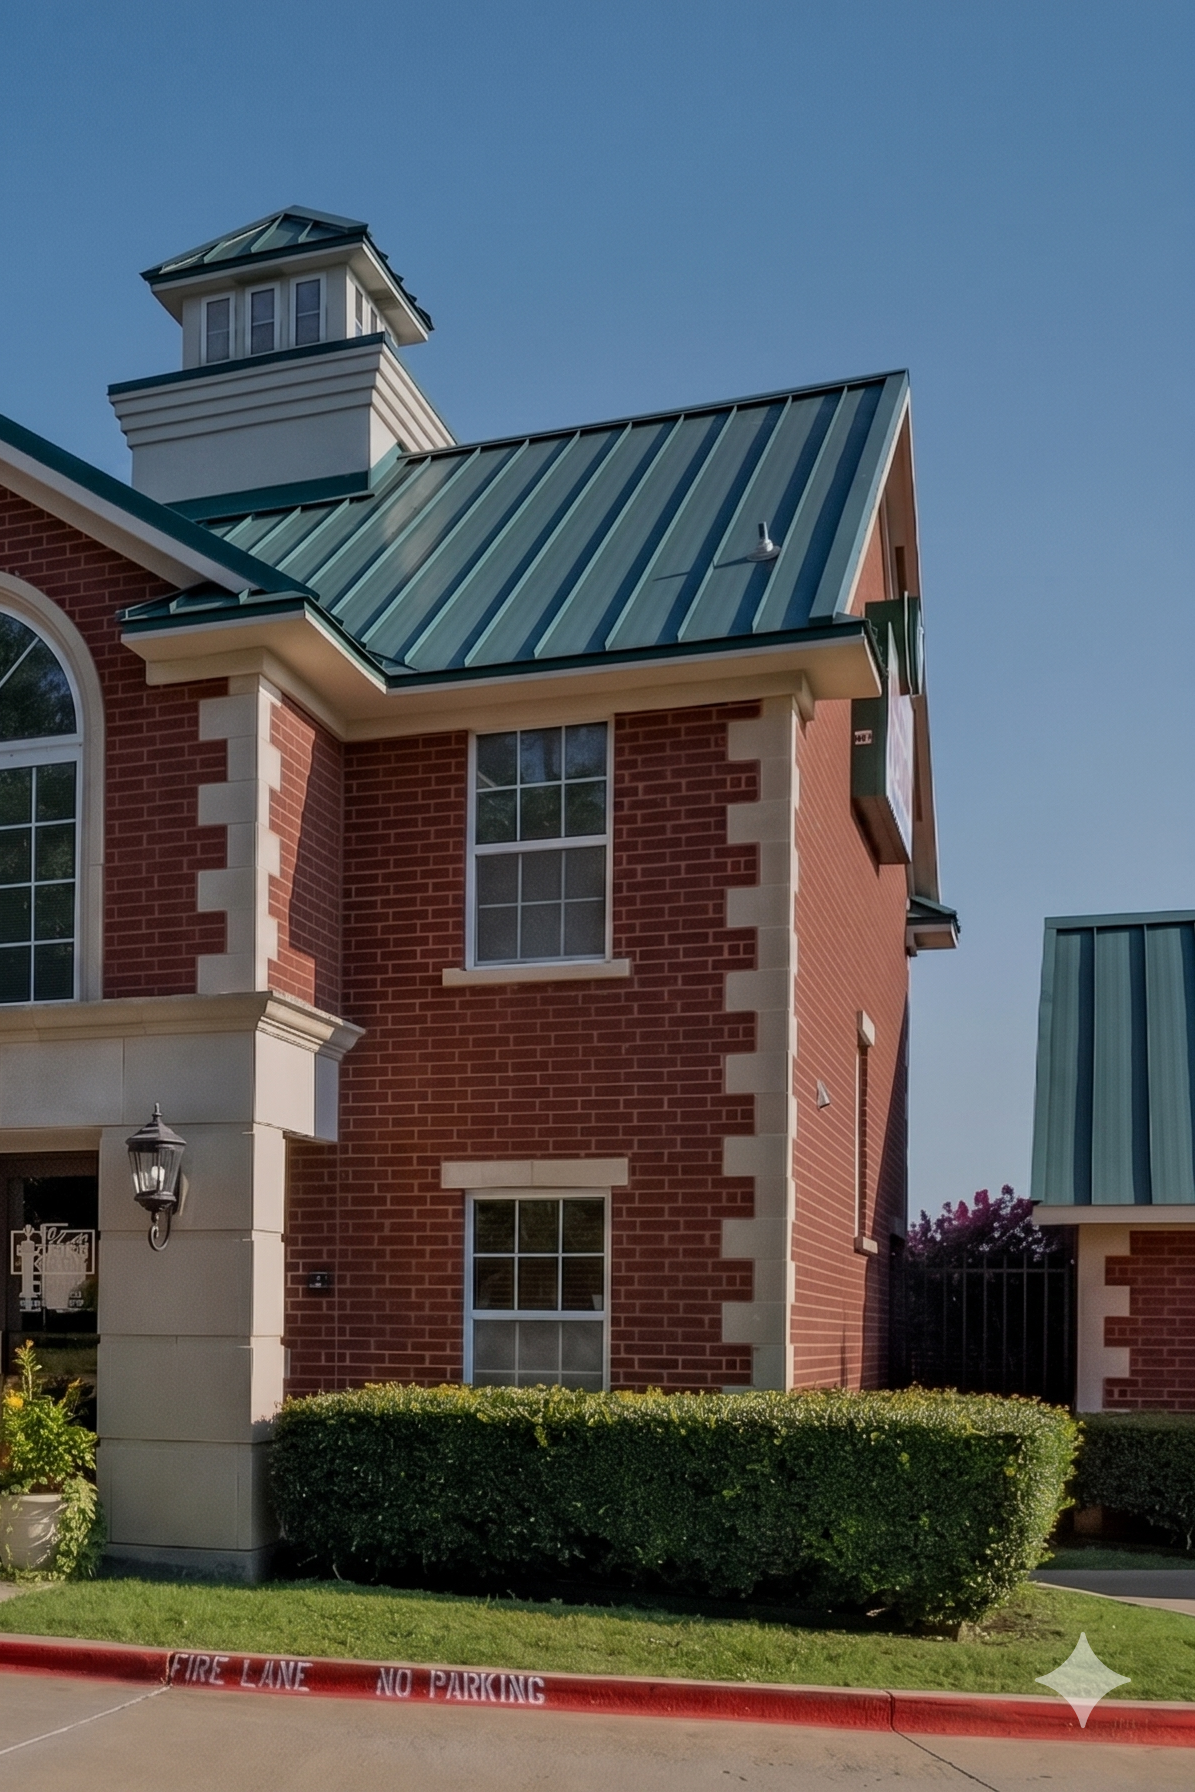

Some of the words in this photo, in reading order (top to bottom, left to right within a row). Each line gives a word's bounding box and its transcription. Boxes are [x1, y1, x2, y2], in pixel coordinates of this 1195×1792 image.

[171, 1653, 230, 1685] FIRE
[241, 1659, 313, 1692] LANE
[376, 1668, 412, 1697] NO
[429, 1670, 546, 1705] PARKING
